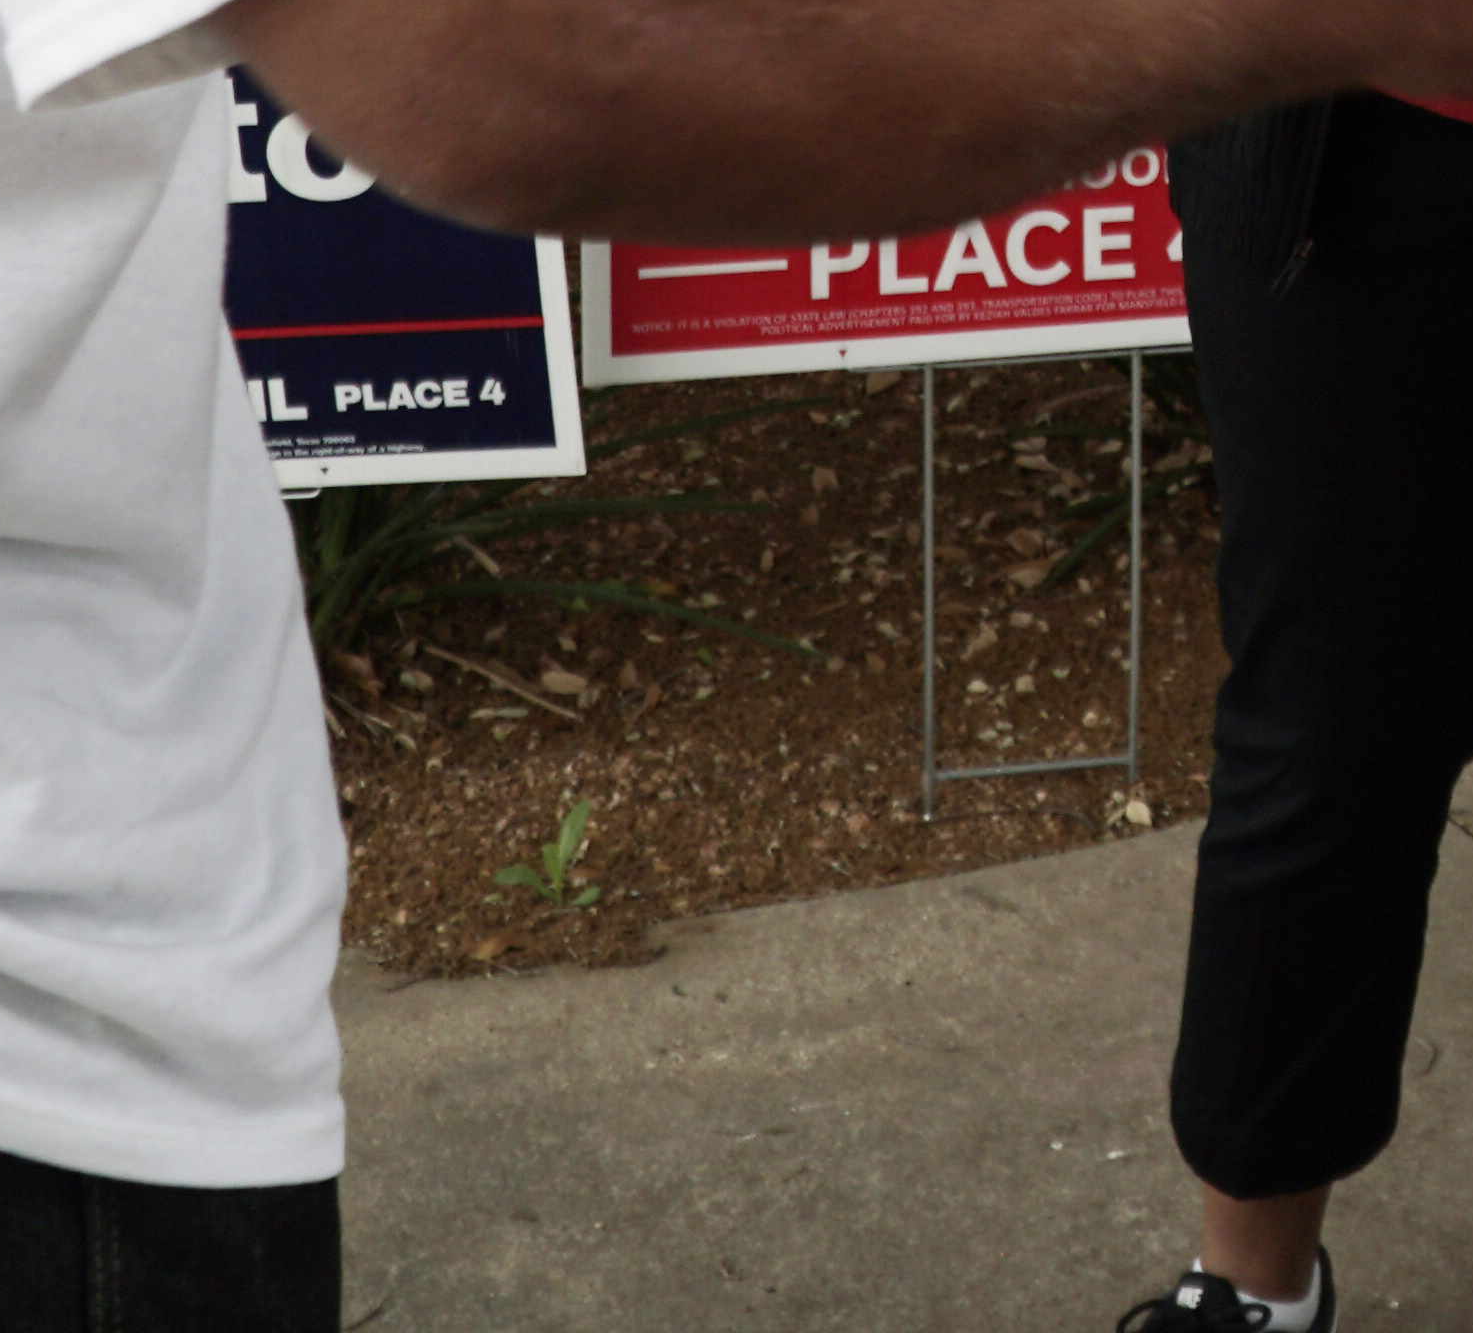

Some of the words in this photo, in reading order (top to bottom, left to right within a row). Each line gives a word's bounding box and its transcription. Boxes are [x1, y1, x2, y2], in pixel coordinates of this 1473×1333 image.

[809, 205, 1136, 300] PLACE
[246, 375, 309, 424] IL
[333, 379, 470, 412] PLACE
[479, 377, 506, 406] 4
